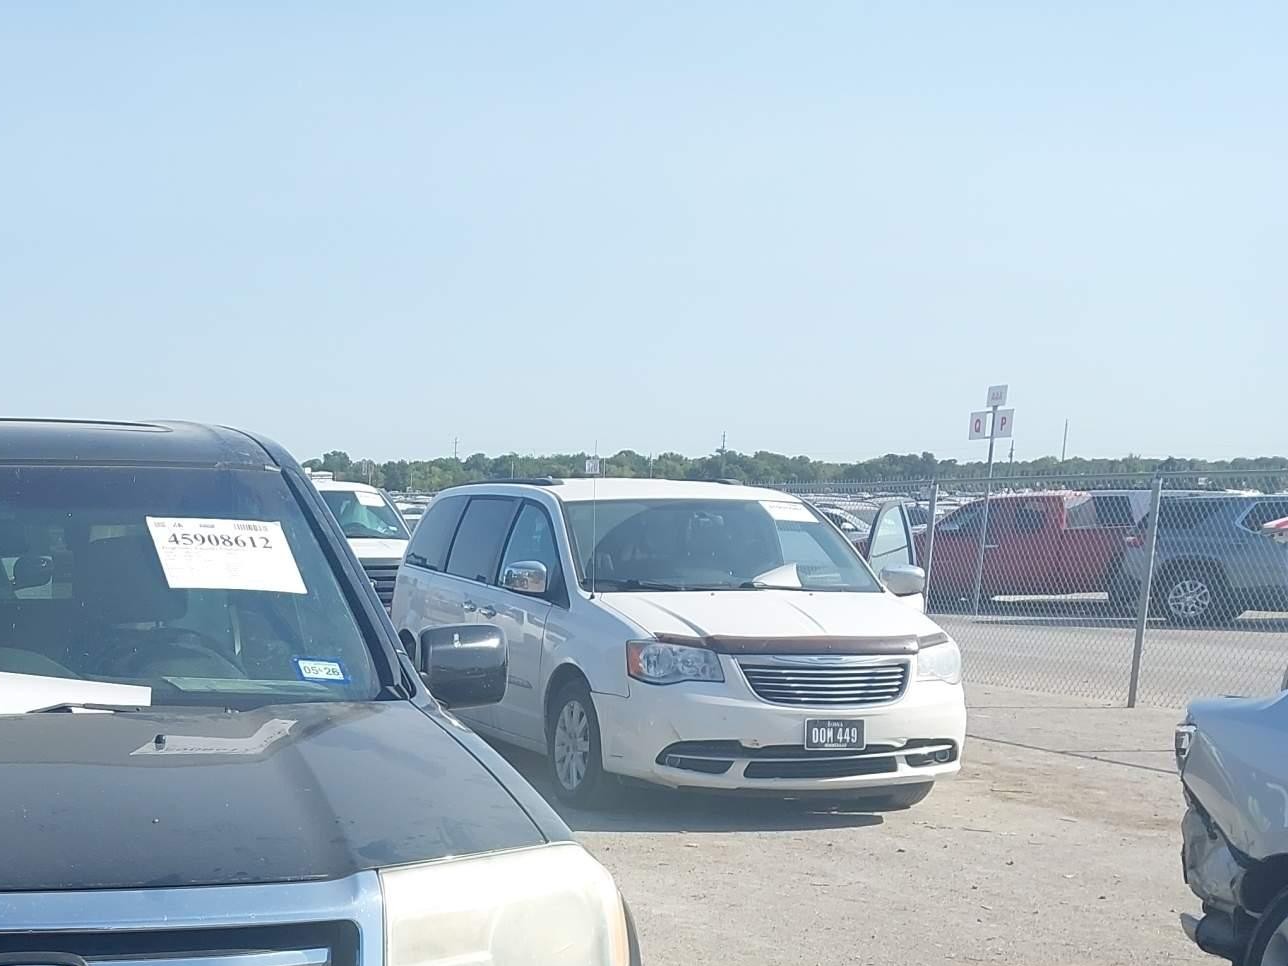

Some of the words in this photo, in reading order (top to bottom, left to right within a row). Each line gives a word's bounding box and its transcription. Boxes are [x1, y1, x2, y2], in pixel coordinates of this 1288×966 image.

[974, 418, 981, 433] Q
[1000, 416, 1007, 431] P
[168, 533, 272, 549] 45908612
[837, 727, 857, 743] 449
